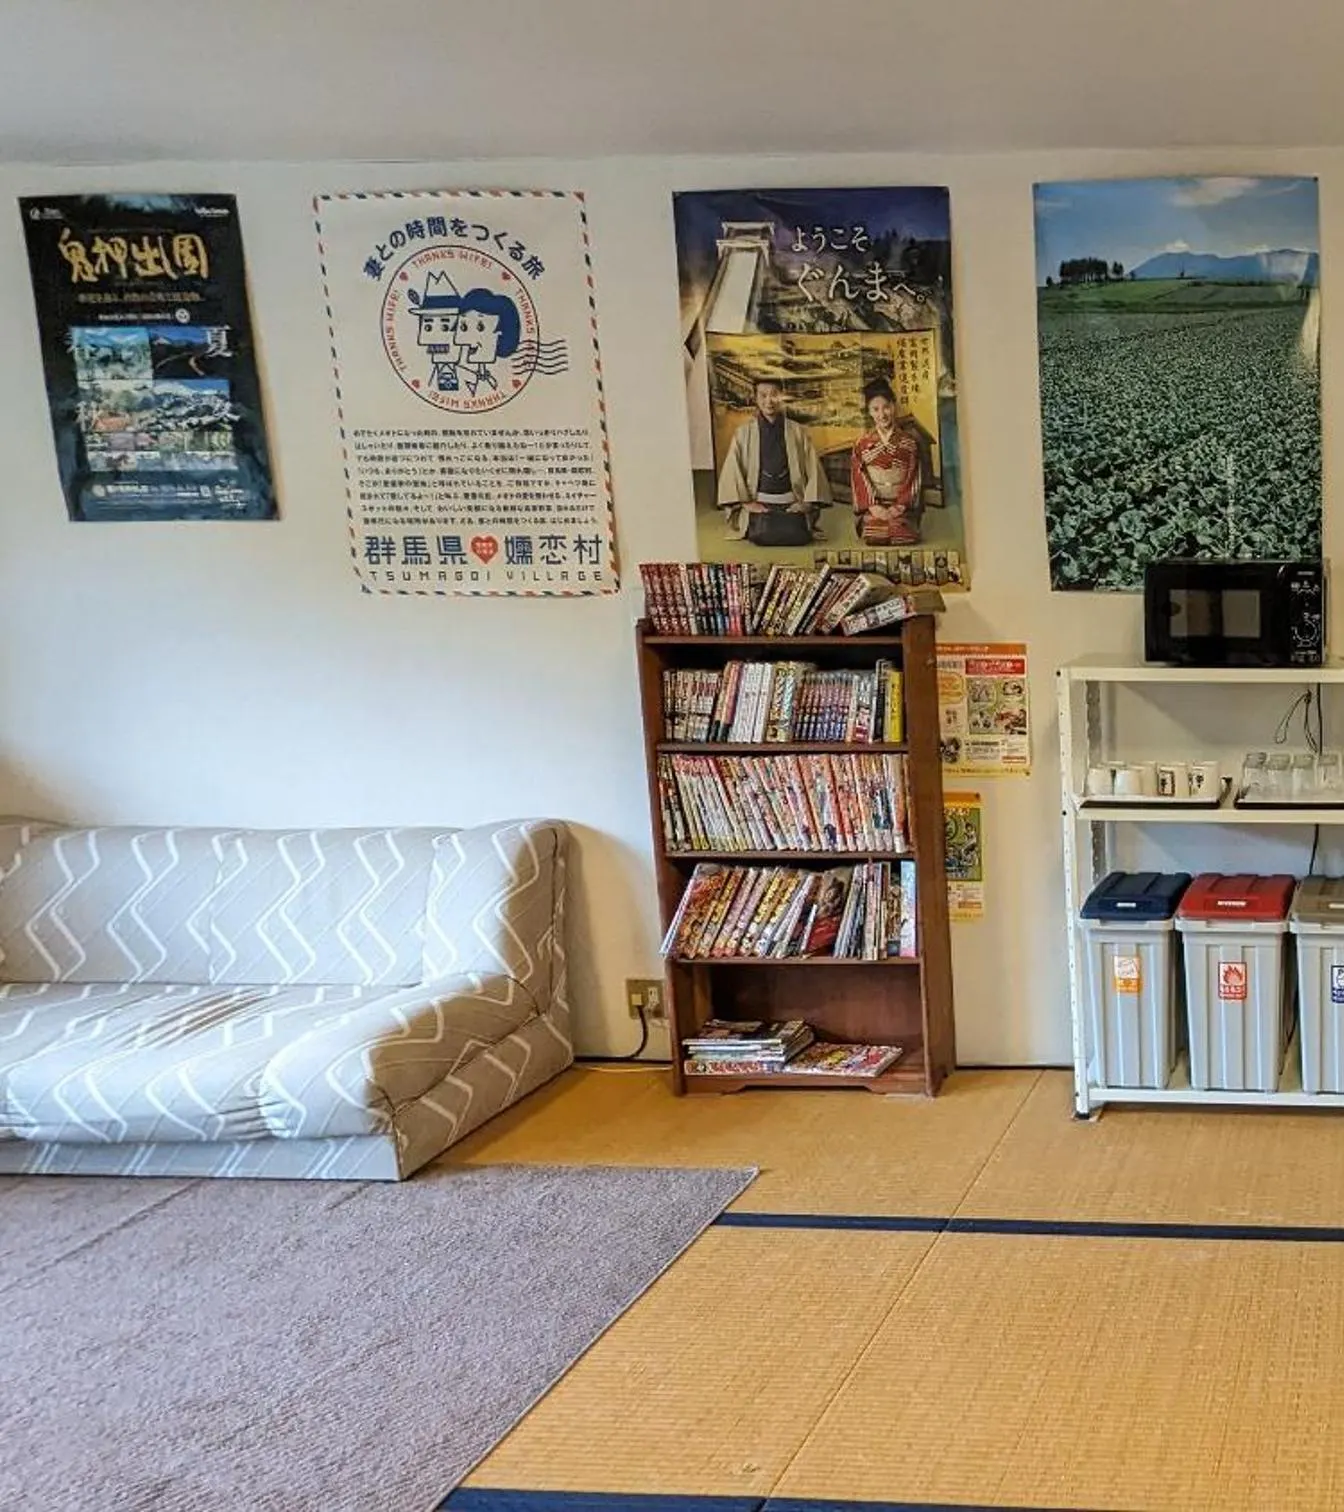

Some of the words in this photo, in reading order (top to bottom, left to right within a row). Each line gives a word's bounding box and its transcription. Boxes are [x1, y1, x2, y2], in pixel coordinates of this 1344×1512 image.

[362, 215, 546, 282] 妻との時間をつくる旅
[792, 225, 869, 252] ようこそ
[205, 325, 233, 358] 夏
[364, 535, 468, 566] 群馬県
[504, 533, 604, 566] 嬬恋村
[368, 570, 492, 582] TSUMAGOI
[505, 570, 603, 582] VILLAGE
